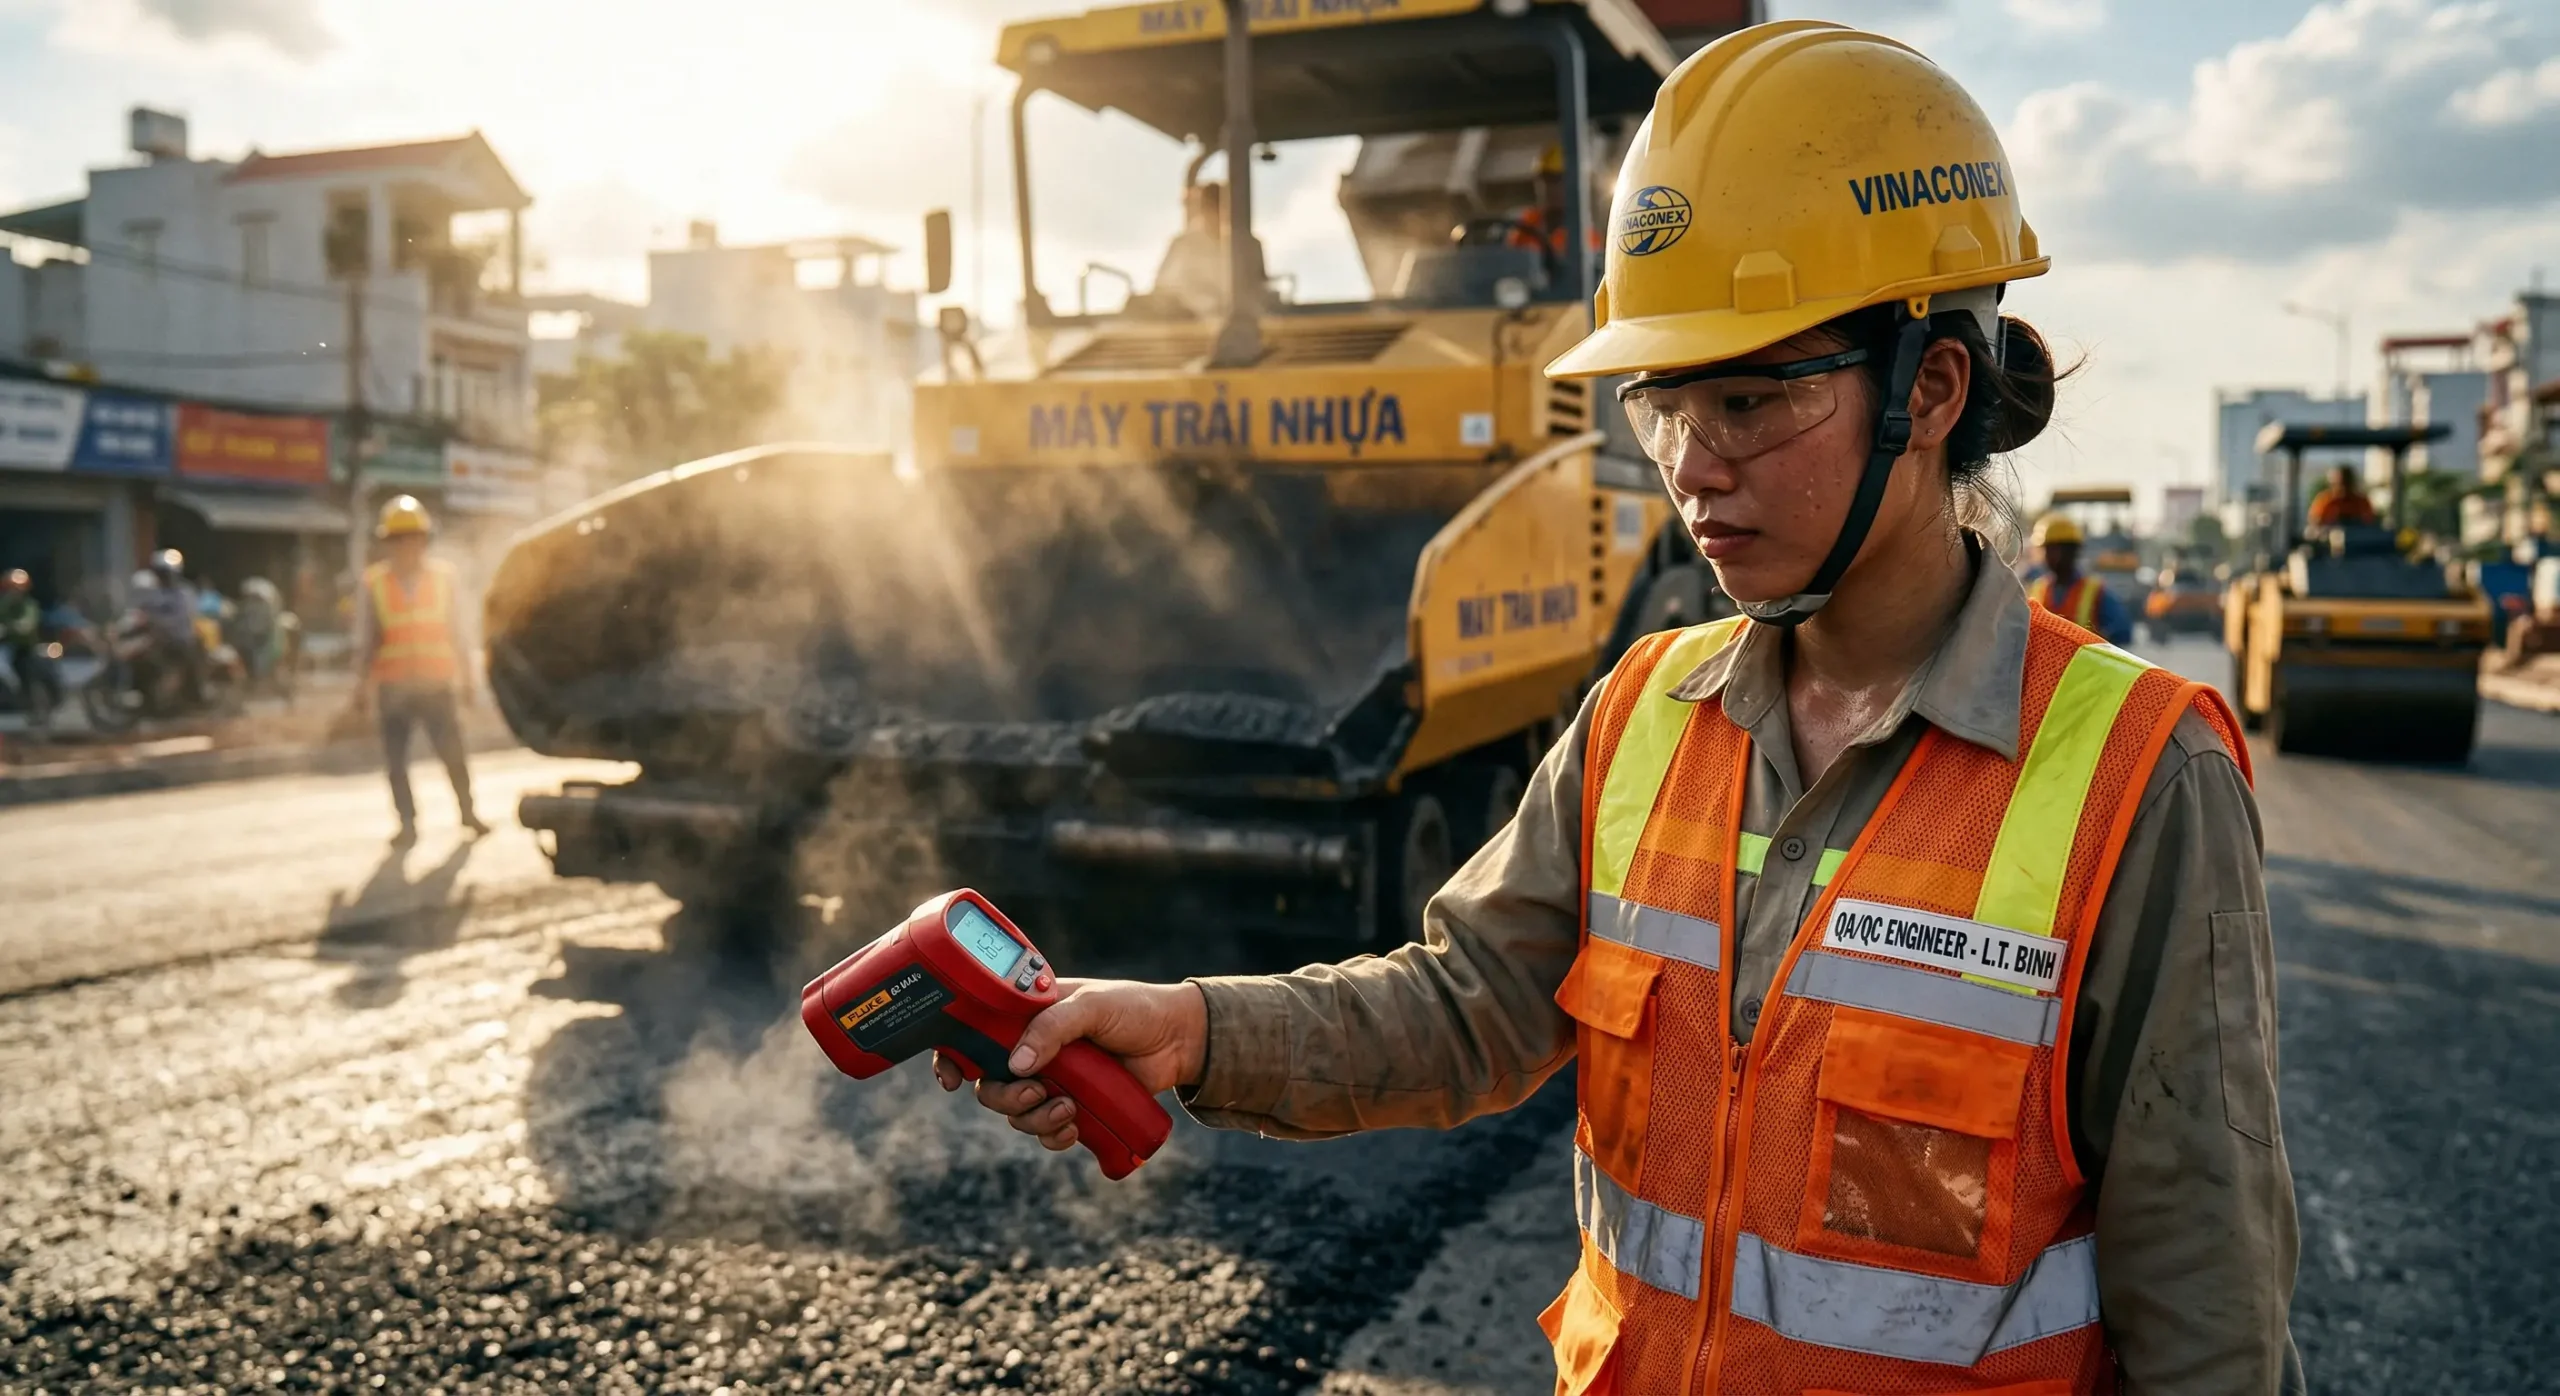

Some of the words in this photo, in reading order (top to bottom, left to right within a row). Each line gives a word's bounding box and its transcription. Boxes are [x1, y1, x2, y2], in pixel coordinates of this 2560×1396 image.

[1849, 161, 2008, 215] VINACONEX
[1029, 390, 1127, 449] MÁY
[1145, 381, 1250, 446] TRẢI
[1270, 386, 1406, 457] NHỰA
[1834, 911, 1883, 946] QA/QC
[1884, 919, 1968, 960] ENGINEER
[1981, 937, 2009, 970] L.T.
[2014, 945, 2057, 980] BINH
[847, 996, 884, 1022] FLUKE
